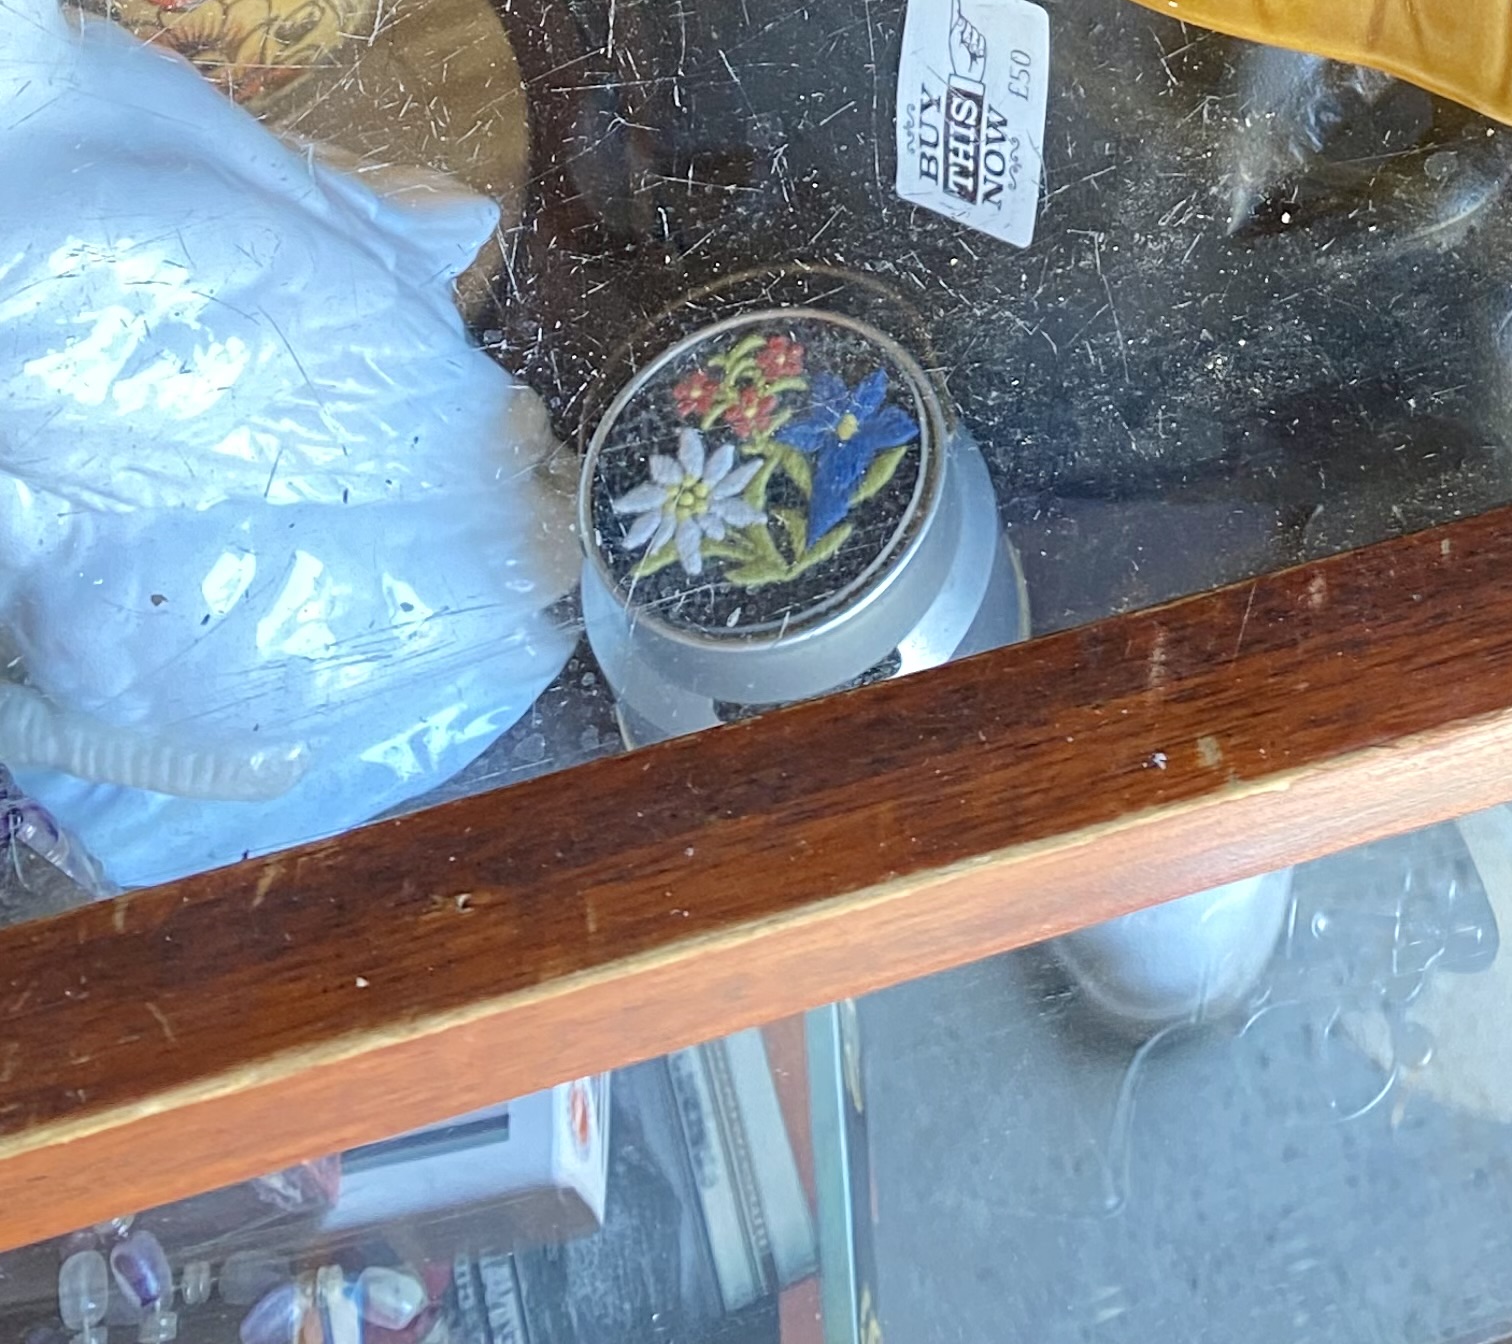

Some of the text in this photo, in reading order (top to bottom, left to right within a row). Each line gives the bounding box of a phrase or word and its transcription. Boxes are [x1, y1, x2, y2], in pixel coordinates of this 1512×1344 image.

[1009, 49, 1031, 101] £50
[919, 83, 941, 185] BUY
[948, 96, 978, 196] THIS
[981, 104, 1008, 210] NOW
